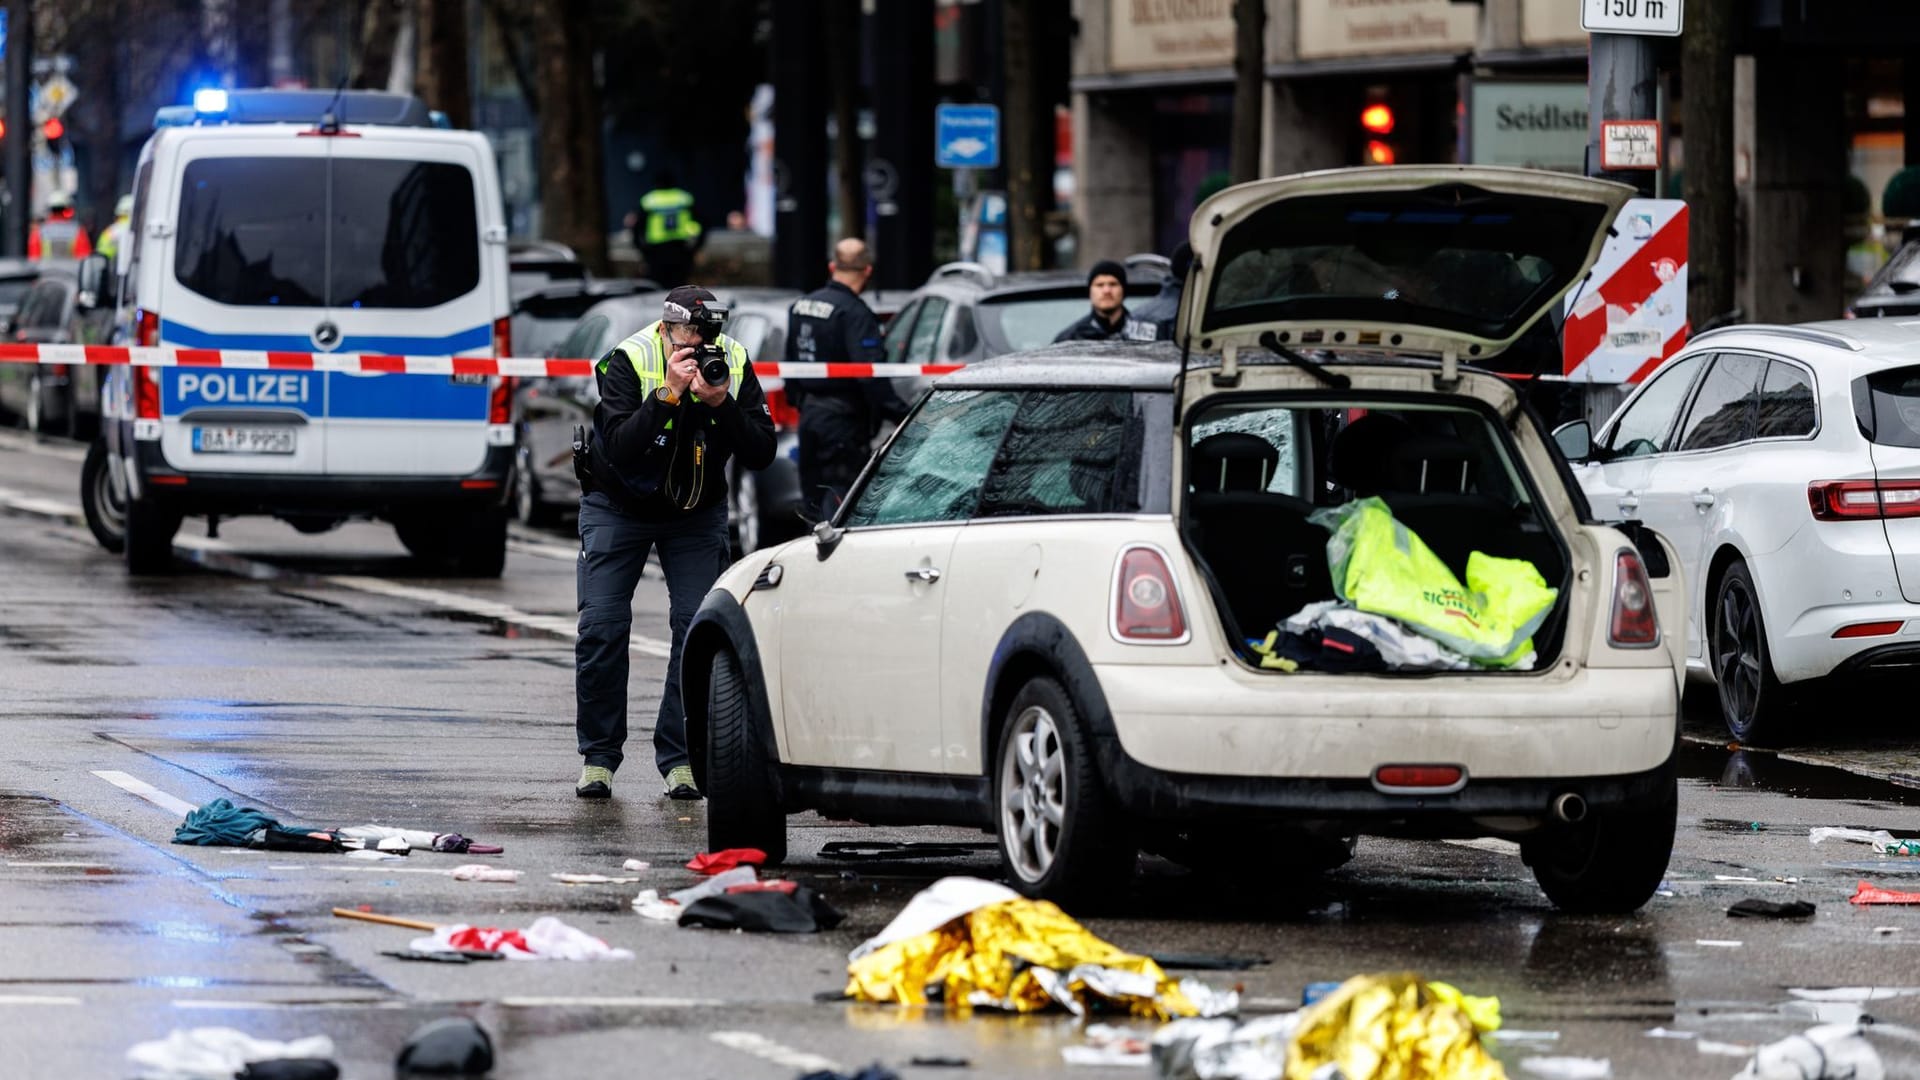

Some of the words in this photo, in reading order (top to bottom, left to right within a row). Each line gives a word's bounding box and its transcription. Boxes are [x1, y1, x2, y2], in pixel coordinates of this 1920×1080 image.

[1604, 0, 1637, 17] 150
[1645, 0, 1664, 18] m
[178, 373, 309, 402] POLIZEI
